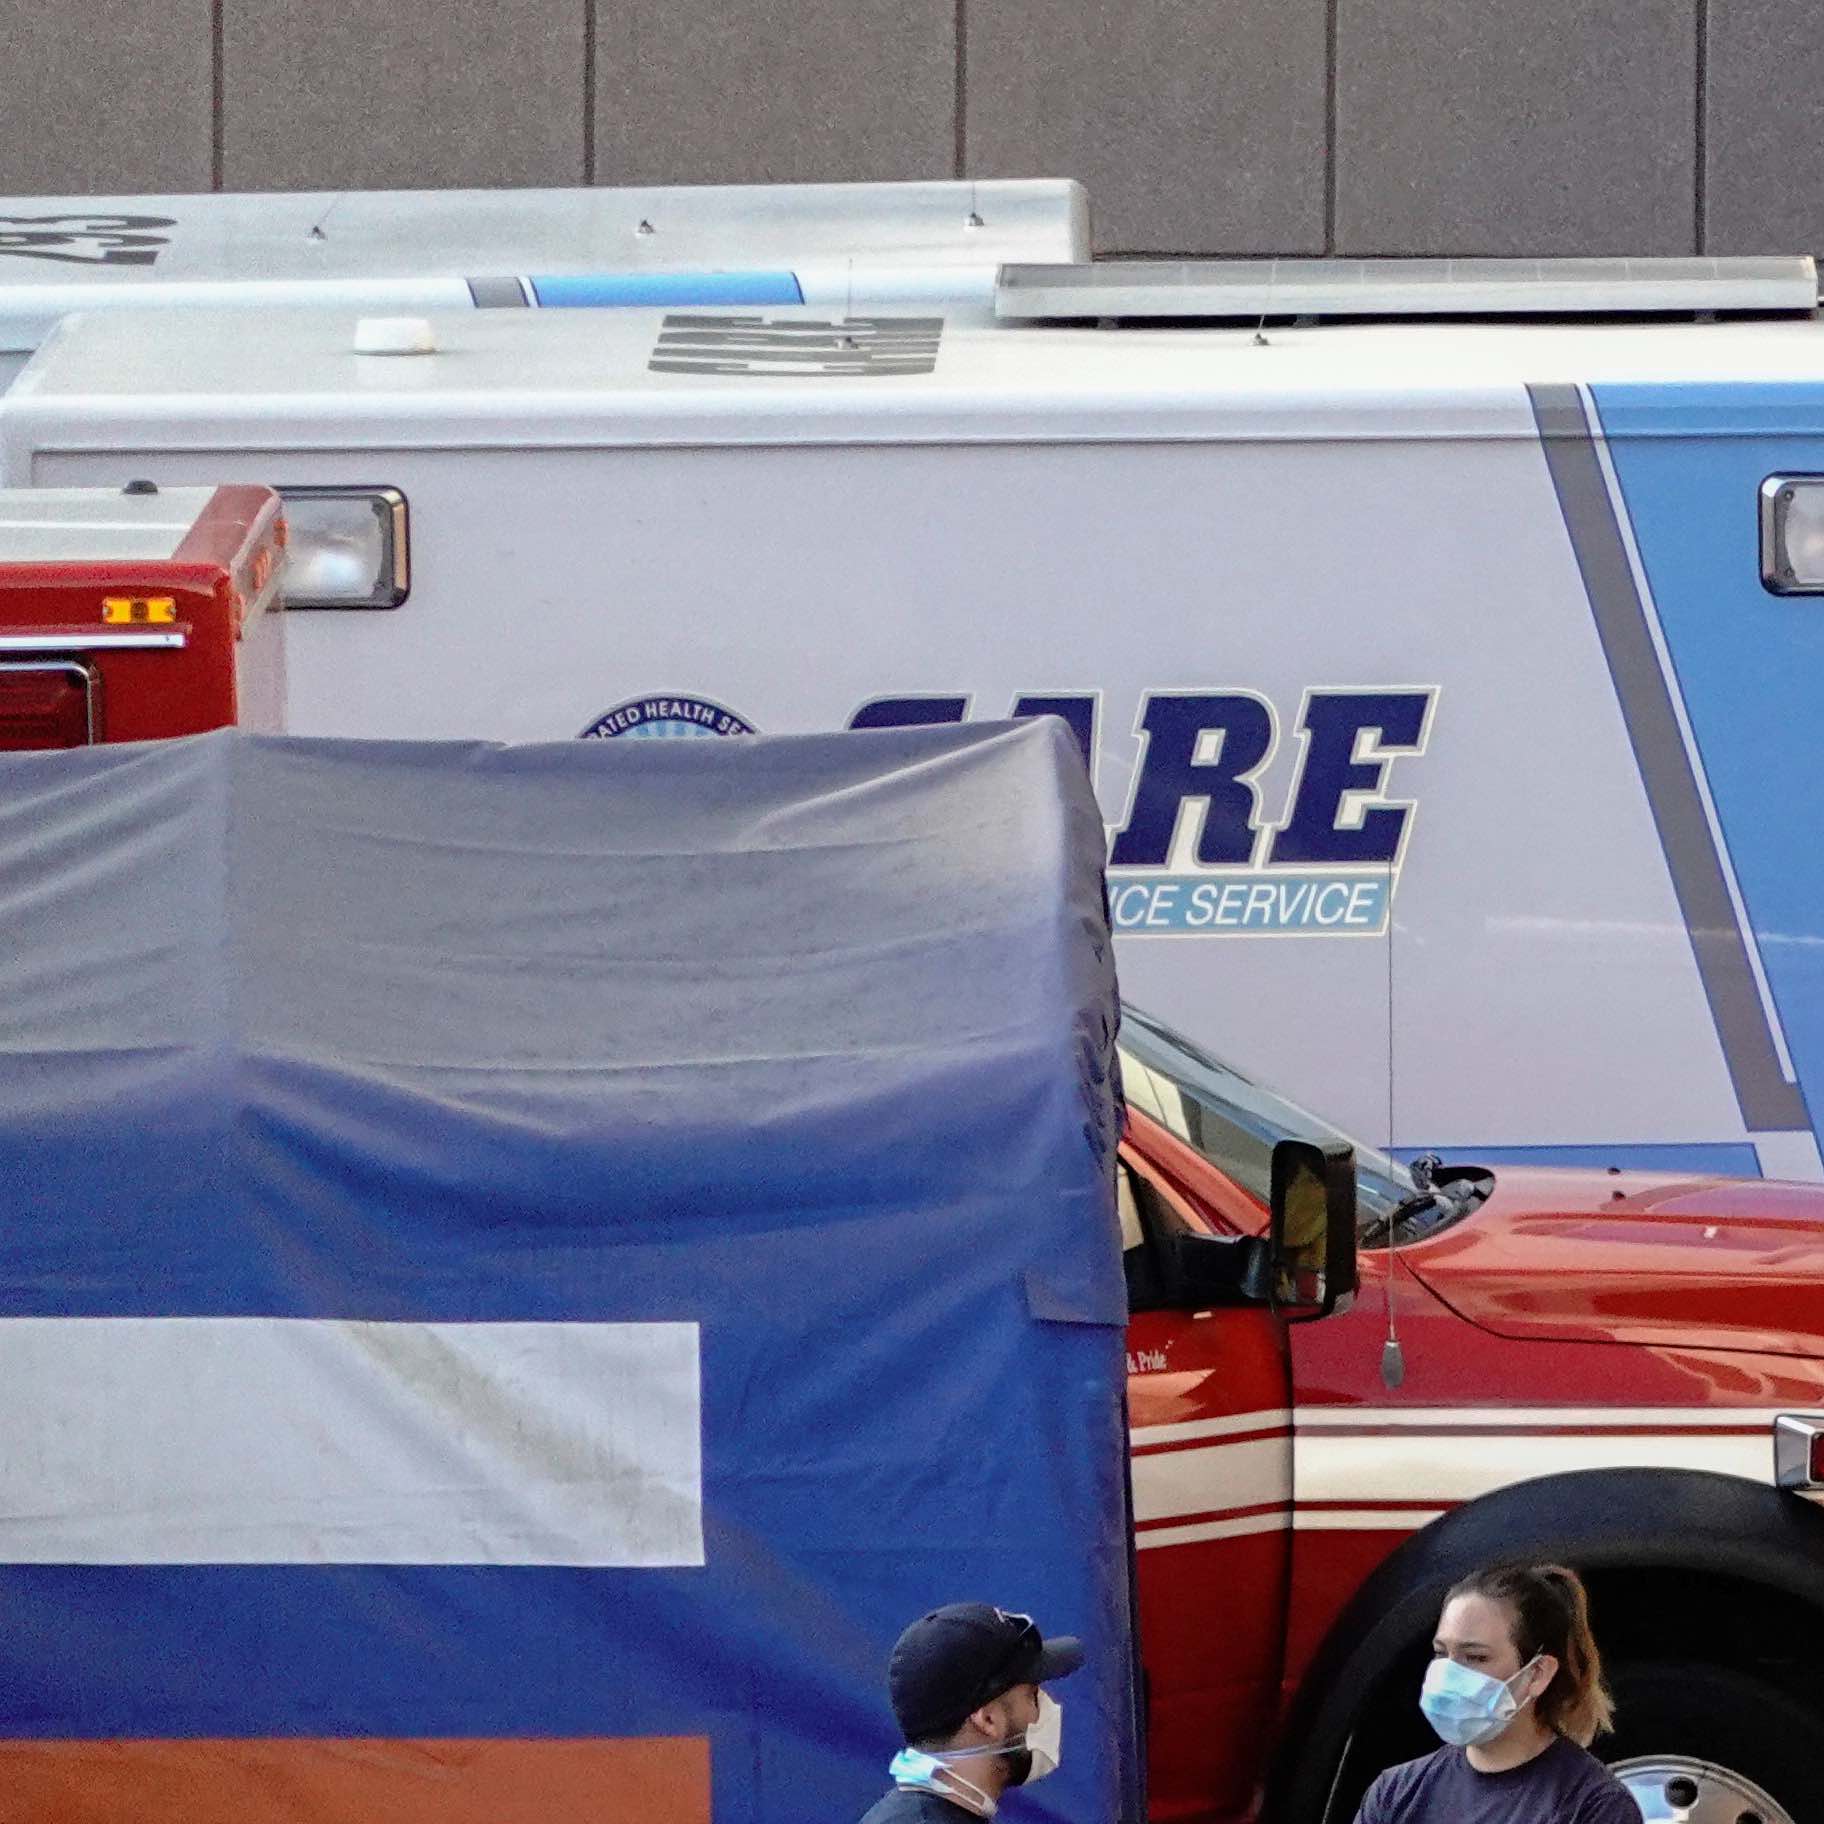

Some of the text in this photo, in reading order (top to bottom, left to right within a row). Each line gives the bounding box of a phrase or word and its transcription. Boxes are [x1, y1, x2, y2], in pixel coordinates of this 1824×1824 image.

[645, 700, 715, 726] HEALTH
[1184, 882, 1379, 927] SERVICE
[1136, 1349, 1168, 1372] Pride
